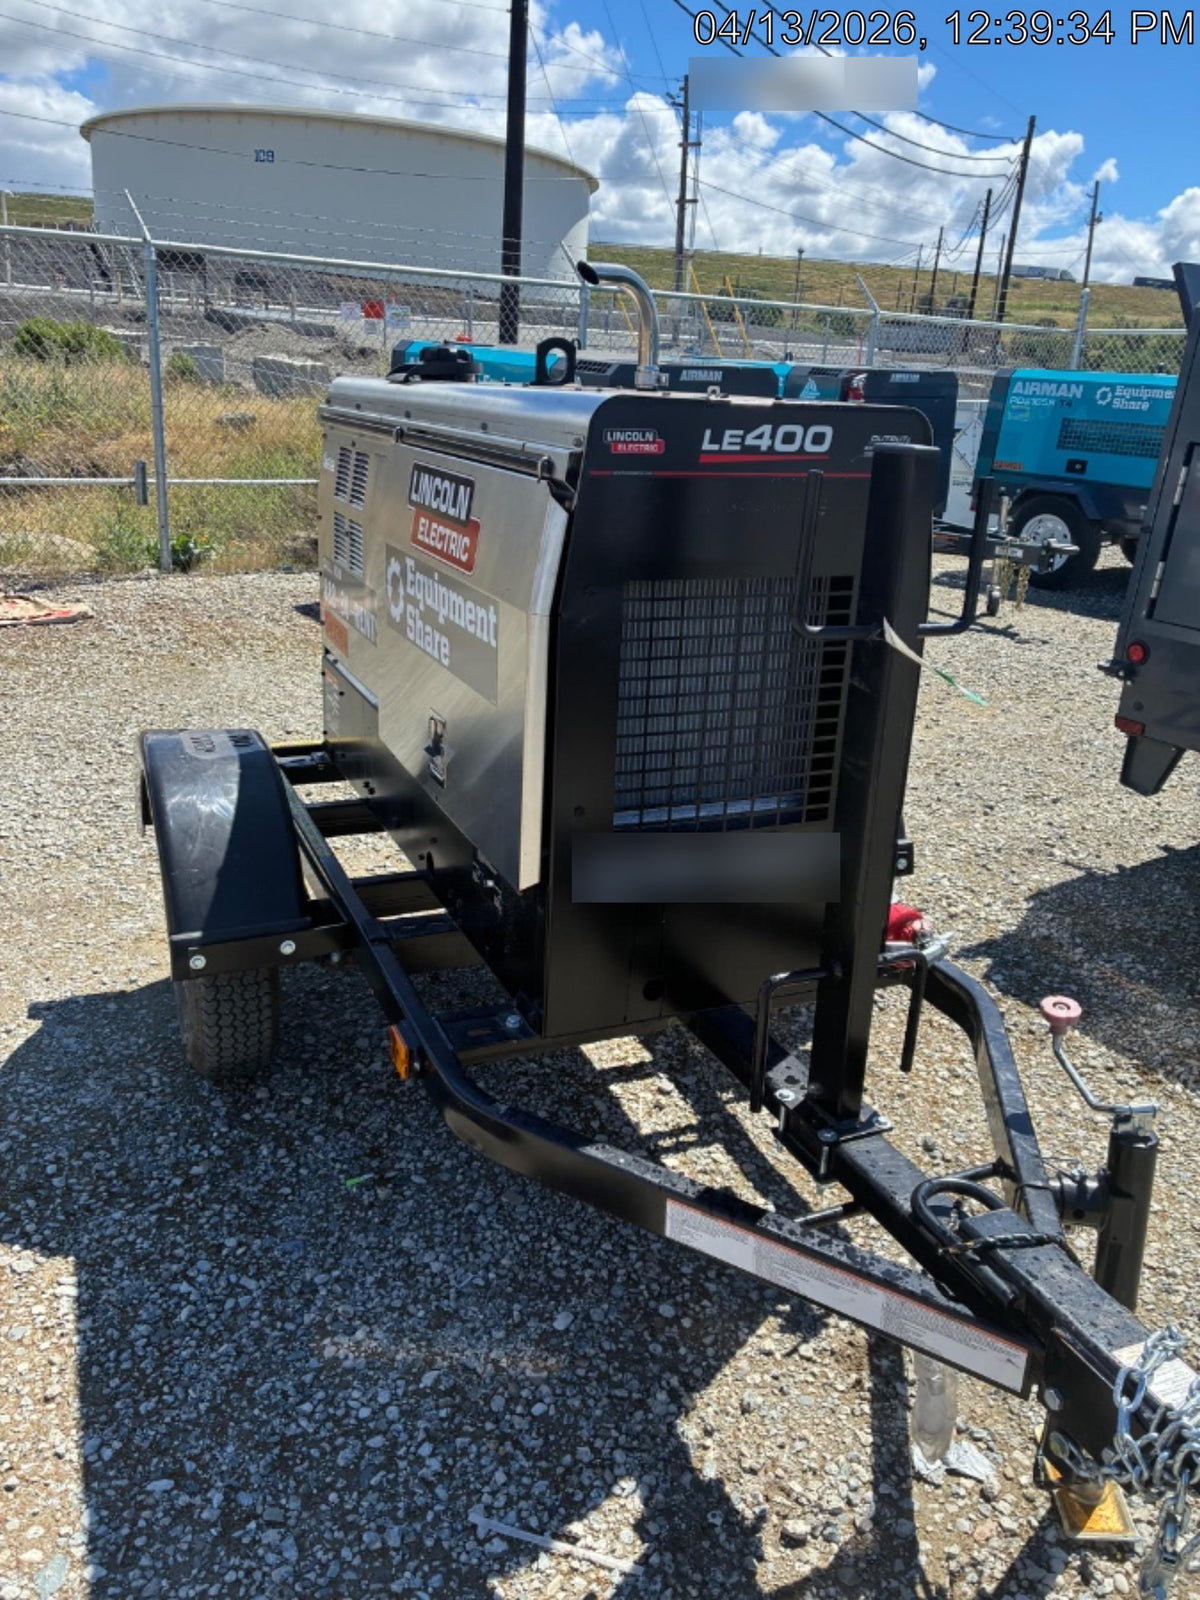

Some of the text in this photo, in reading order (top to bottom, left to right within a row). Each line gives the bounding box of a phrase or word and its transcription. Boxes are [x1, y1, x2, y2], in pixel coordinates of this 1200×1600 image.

[1012, 381, 1084, 399] AIRMAN
[1112, 397, 1149, 411] Share
[607, 431, 654, 442] LINCOLN
[702, 424, 834, 453] LE400
[410, 470, 471, 521] LINCOLN
[417, 516, 471, 563] ELECTRIC
[405, 556, 497, 648] Equipment
[406, 604, 450, 667] Share
